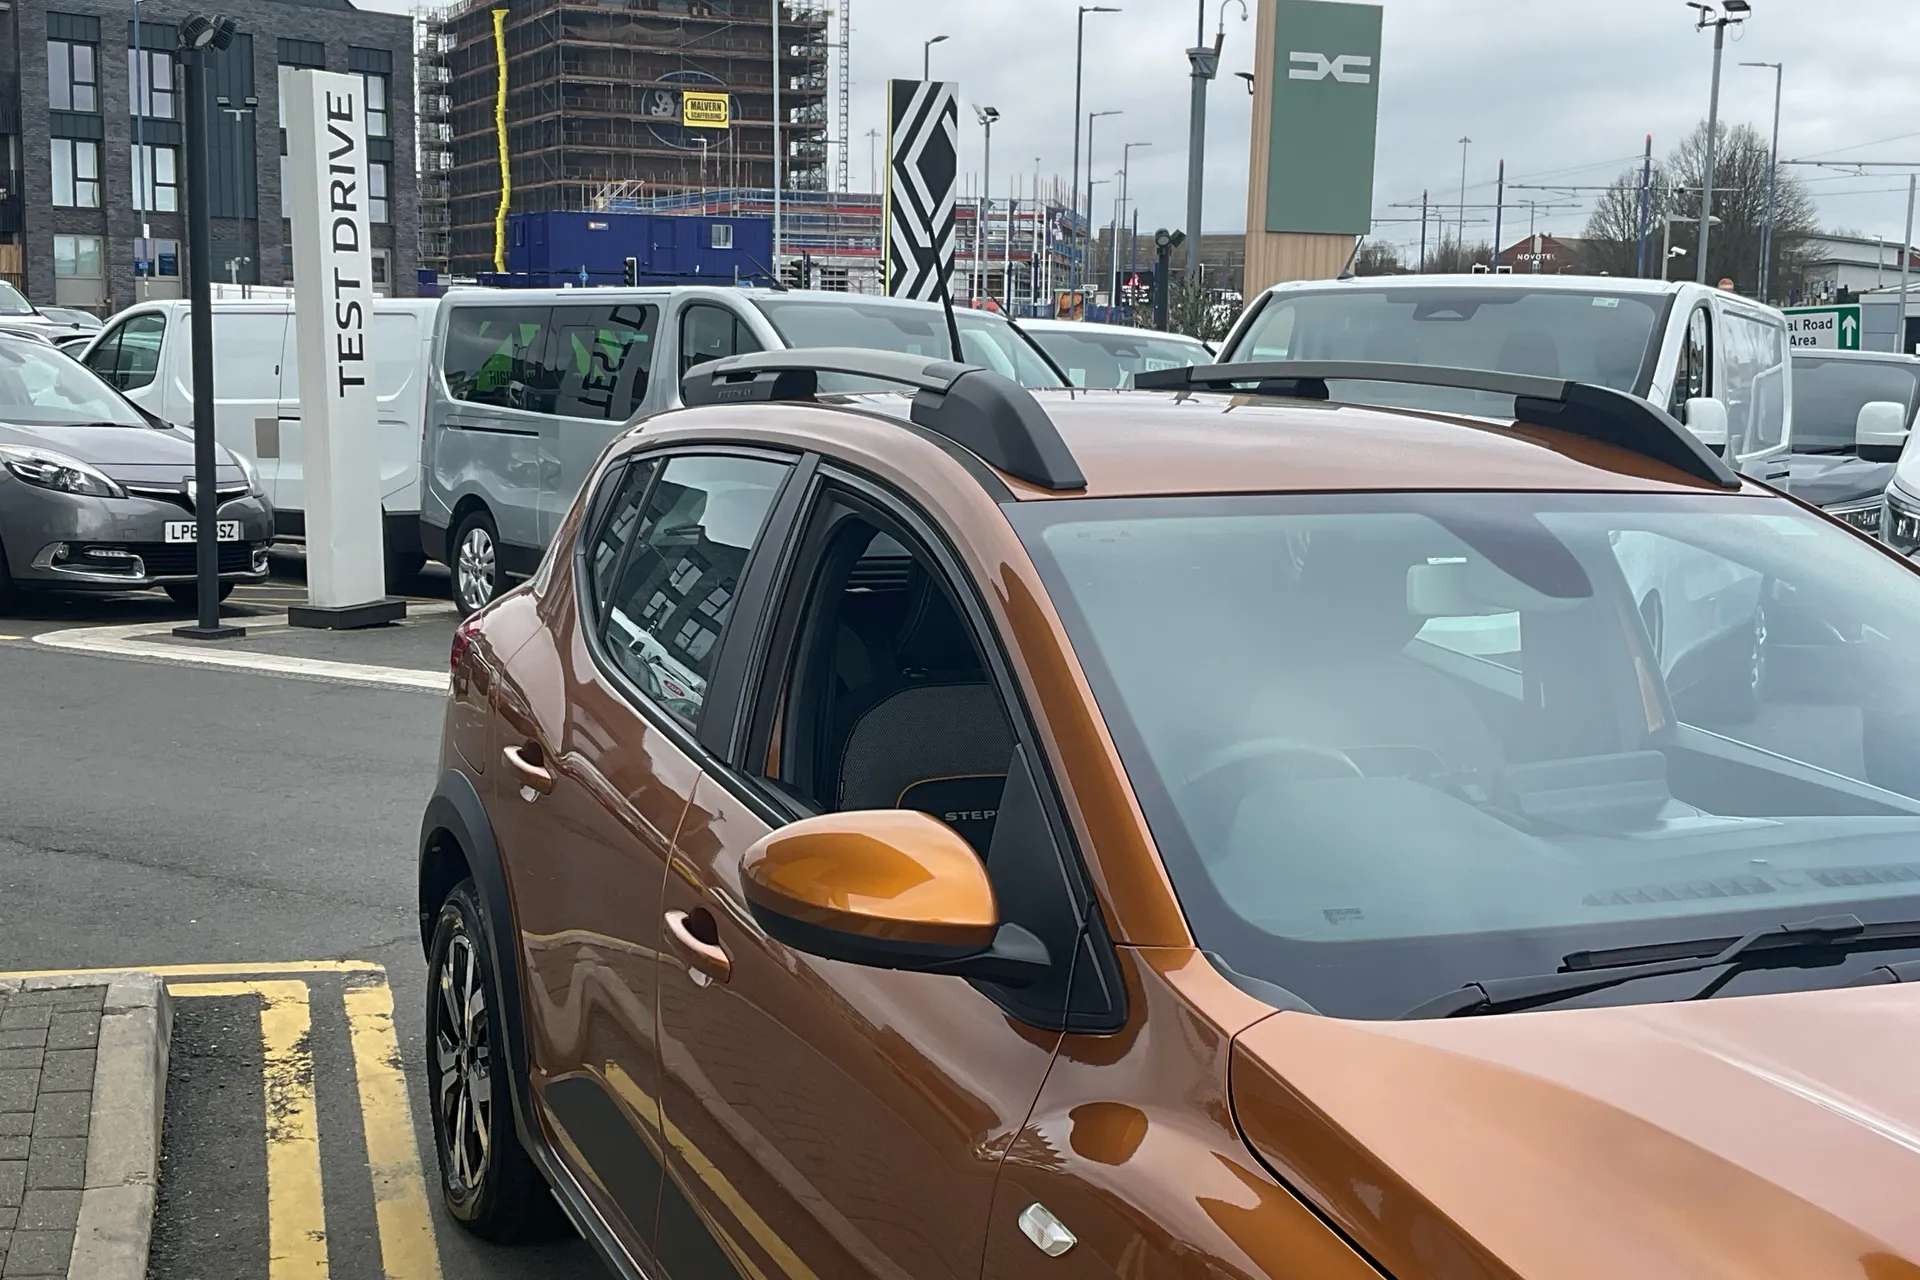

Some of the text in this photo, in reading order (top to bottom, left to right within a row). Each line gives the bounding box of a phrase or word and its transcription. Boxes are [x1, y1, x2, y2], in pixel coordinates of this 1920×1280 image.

[690, 100, 722, 112] MALVERN
[326, 90, 366, 398] TEST DRIVE
[1516, 252, 1556, 261] NOVOTEL
[1803, 318, 1833, 331] Road
[1790, 335, 1817, 346] Area
[944, 809, 999, 821] STEP
